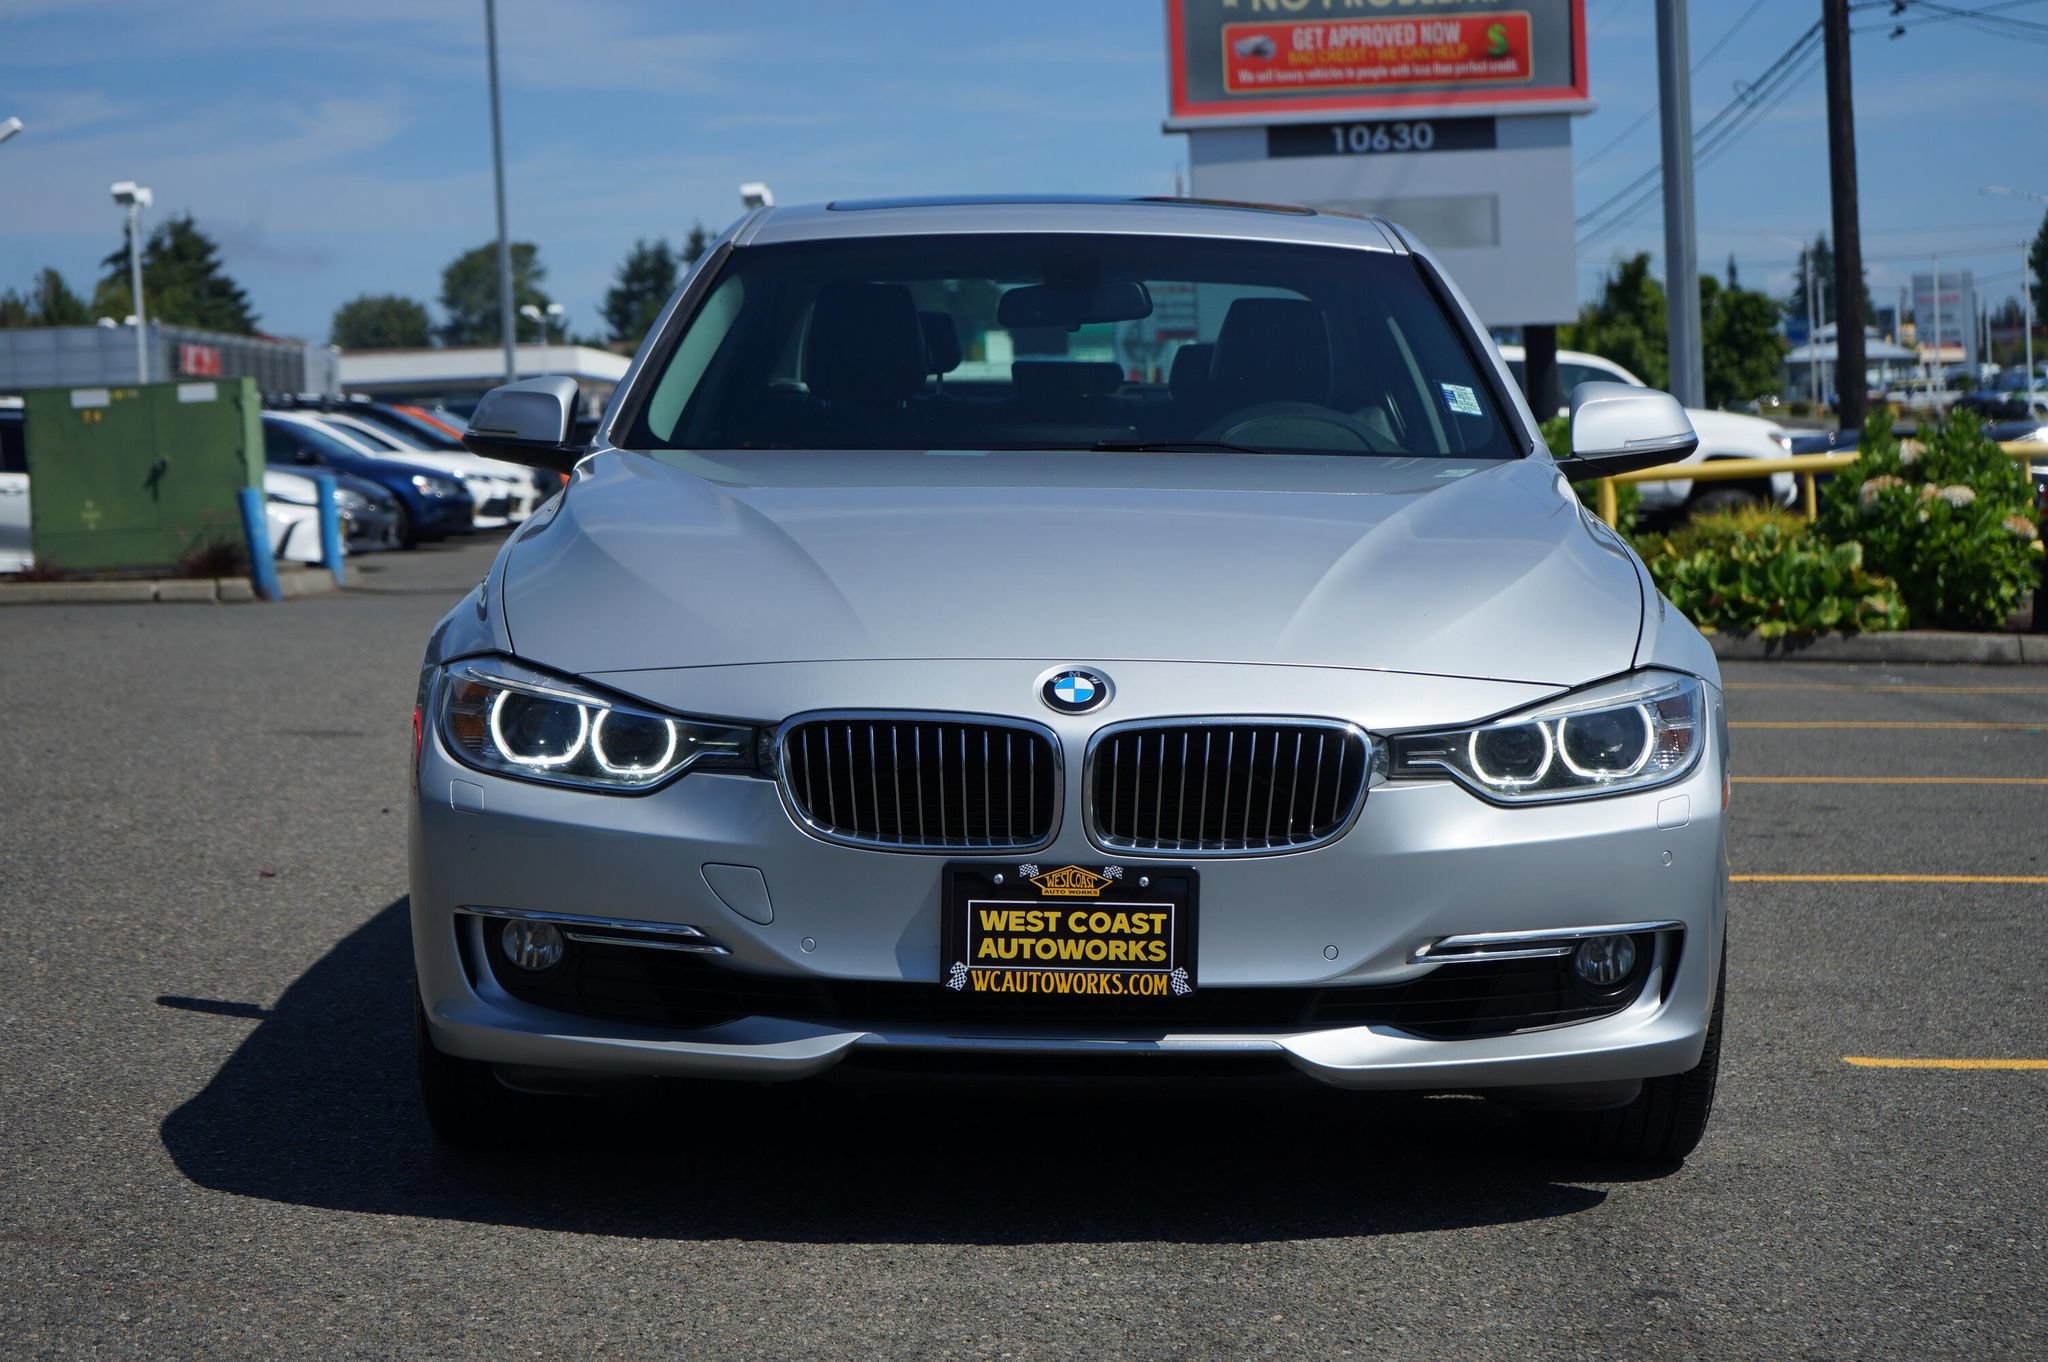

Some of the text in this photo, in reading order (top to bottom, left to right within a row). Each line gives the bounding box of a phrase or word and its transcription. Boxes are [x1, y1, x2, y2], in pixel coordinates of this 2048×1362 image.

[1292, 20, 1461, 50] GET APPROVED NOW
[1318, 47, 1367, 64] CREDIT
[1401, 44, 1429, 61] CAN
[1432, 42, 1468, 60] HELP
[1238, 69, 1255, 82] We
[1356, 64, 1388, 80] people
[1390, 62, 1410, 76] with
[1455, 58, 1488, 75] perfect
[1331, 122, 1434, 153] 10630
[979, 910, 1168, 935] WEST COAST
[977, 937, 1167, 962] AUTOWORKS
[970, 970, 1169, 996] WCAUTOWORKS.COM
